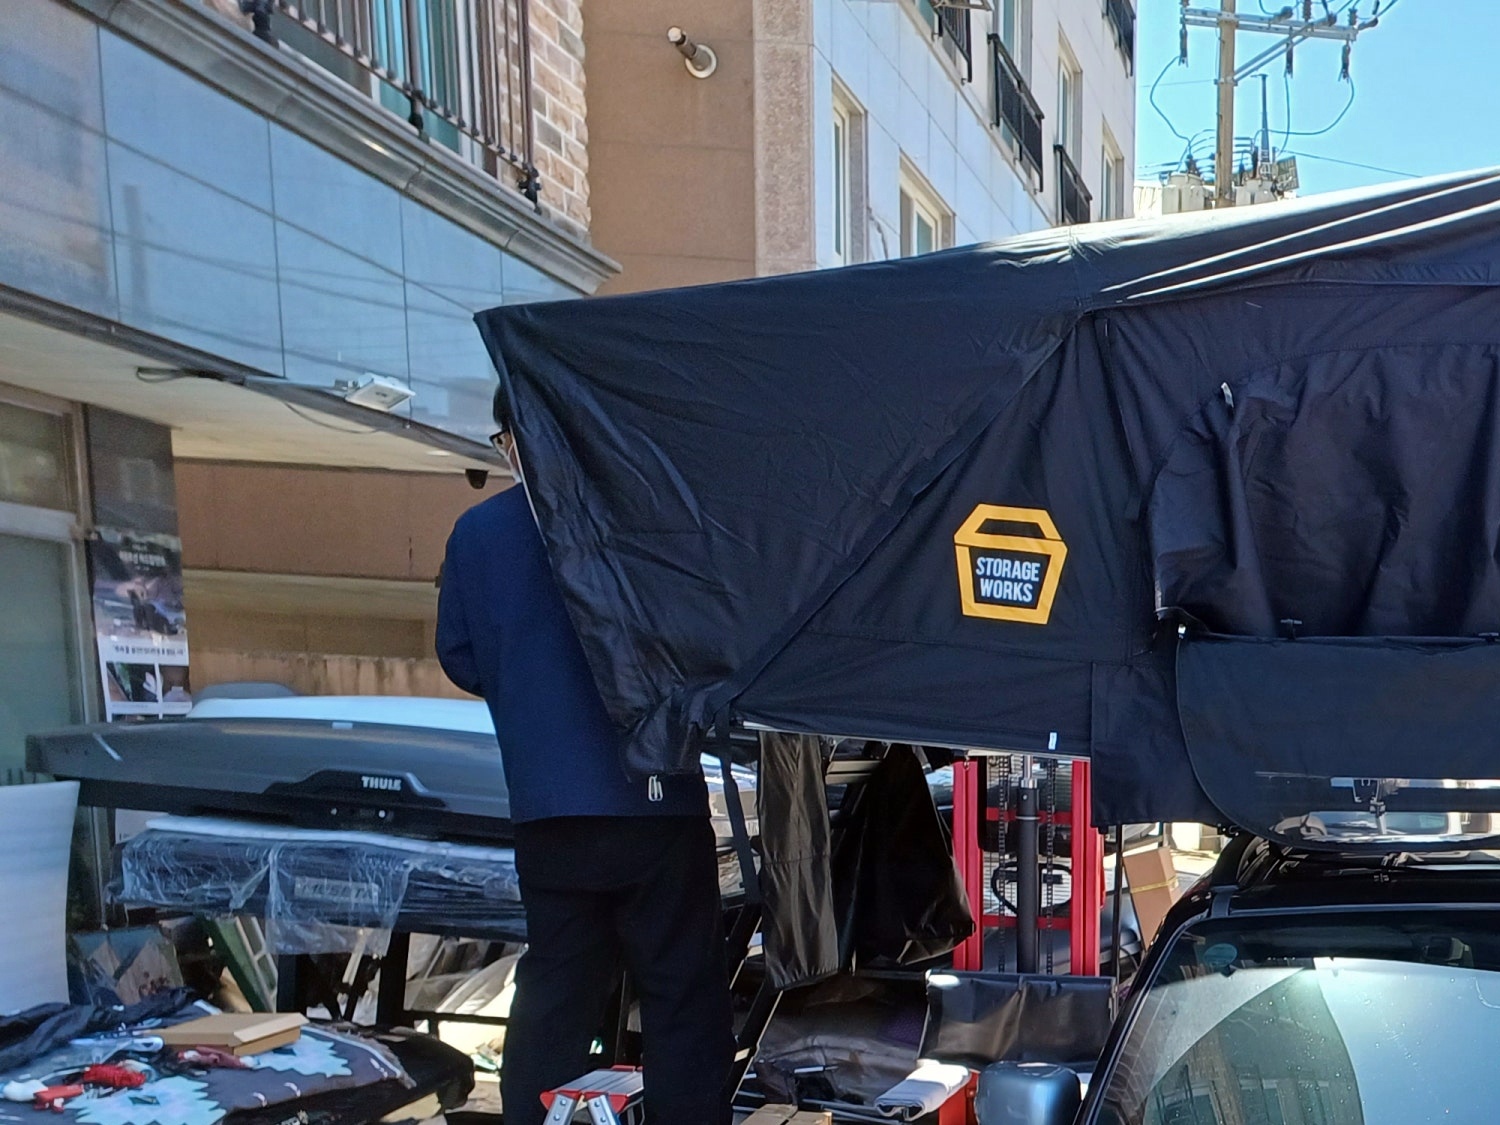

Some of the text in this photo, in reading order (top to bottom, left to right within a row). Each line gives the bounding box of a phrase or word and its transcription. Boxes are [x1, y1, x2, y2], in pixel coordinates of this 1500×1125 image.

[975, 556, 1041, 582] STORAGE
[979, 577, 1034, 603] WORKS
[361, 775, 402, 791] THULE
